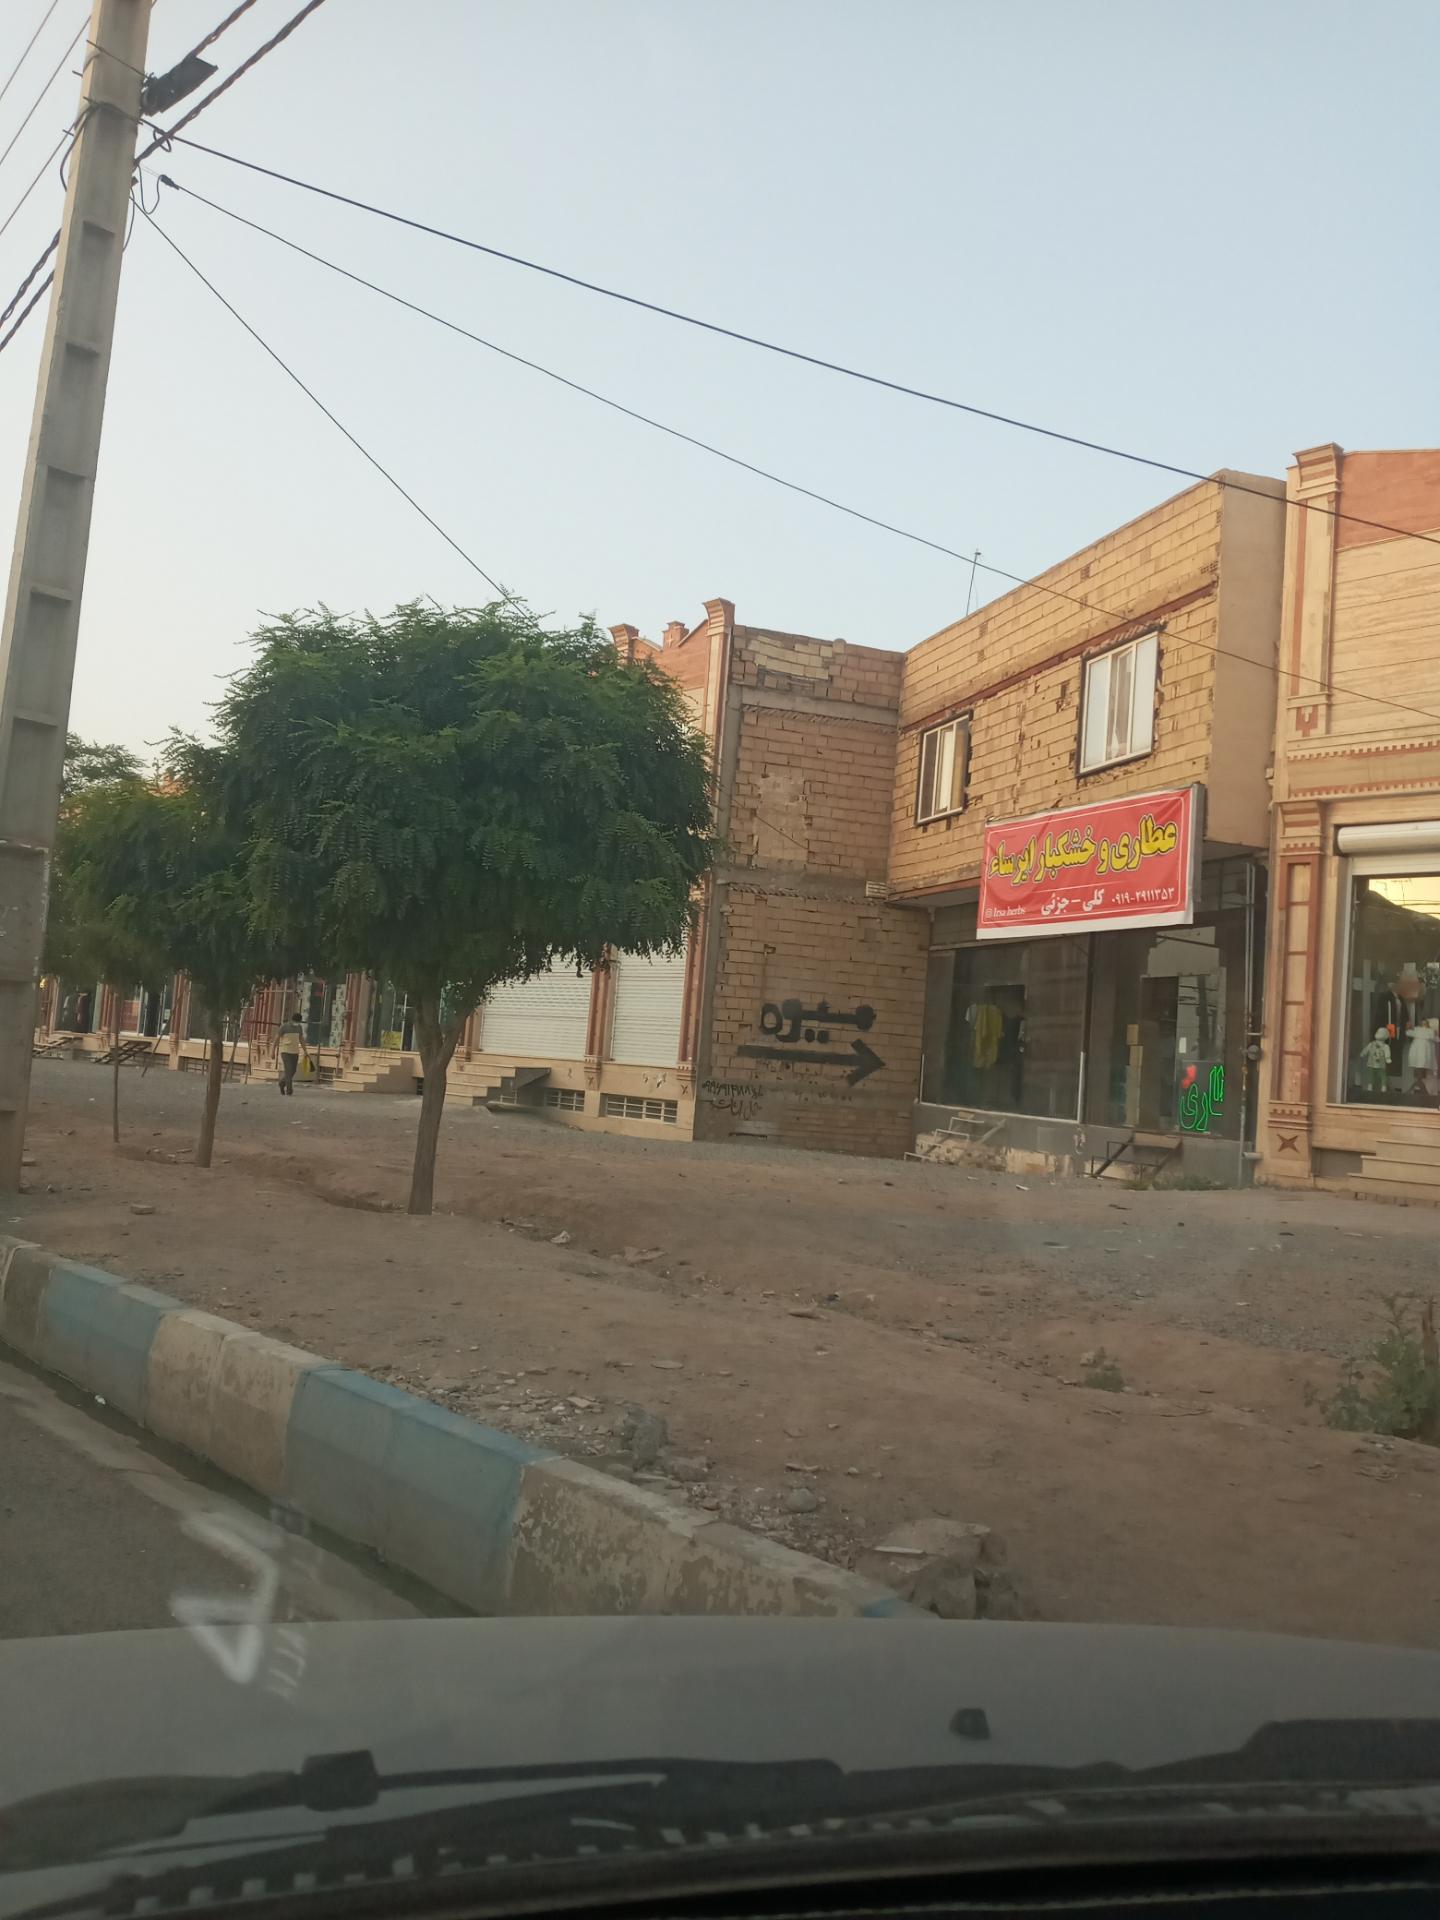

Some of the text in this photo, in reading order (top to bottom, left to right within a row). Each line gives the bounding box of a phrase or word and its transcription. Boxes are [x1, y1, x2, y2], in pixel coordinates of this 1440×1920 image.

[1035, 826, 1096, 882] خشکبار
[1097, 839, 1109, 874] و
[1111, 814, 1177, 871] عطاری
